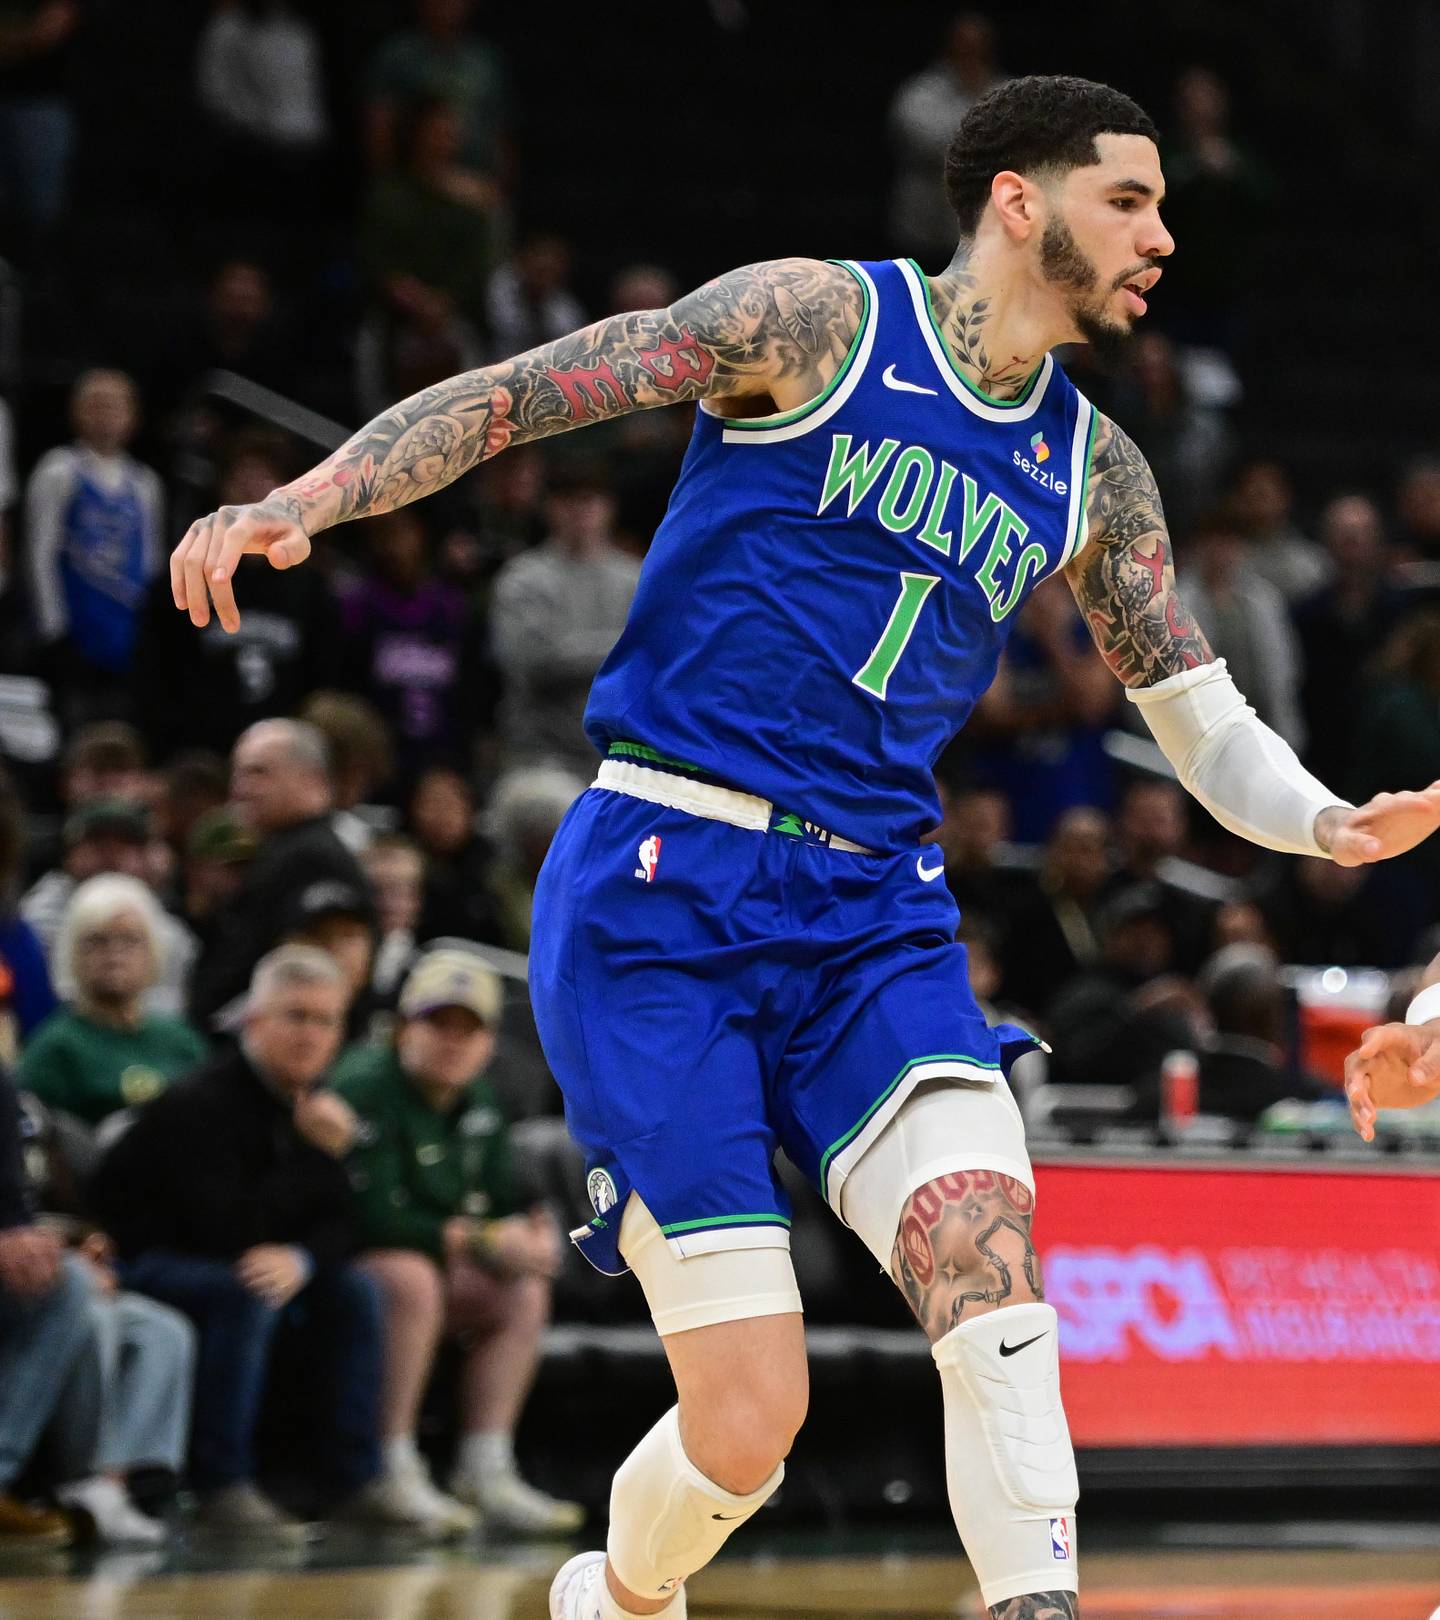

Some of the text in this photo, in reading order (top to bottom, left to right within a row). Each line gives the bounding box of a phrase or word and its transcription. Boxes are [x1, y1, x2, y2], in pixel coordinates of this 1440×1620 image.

[817, 433, 1047, 623] WOLVES
[1012, 450, 1068, 495] sezzle
[851, 571, 942, 701] 1
